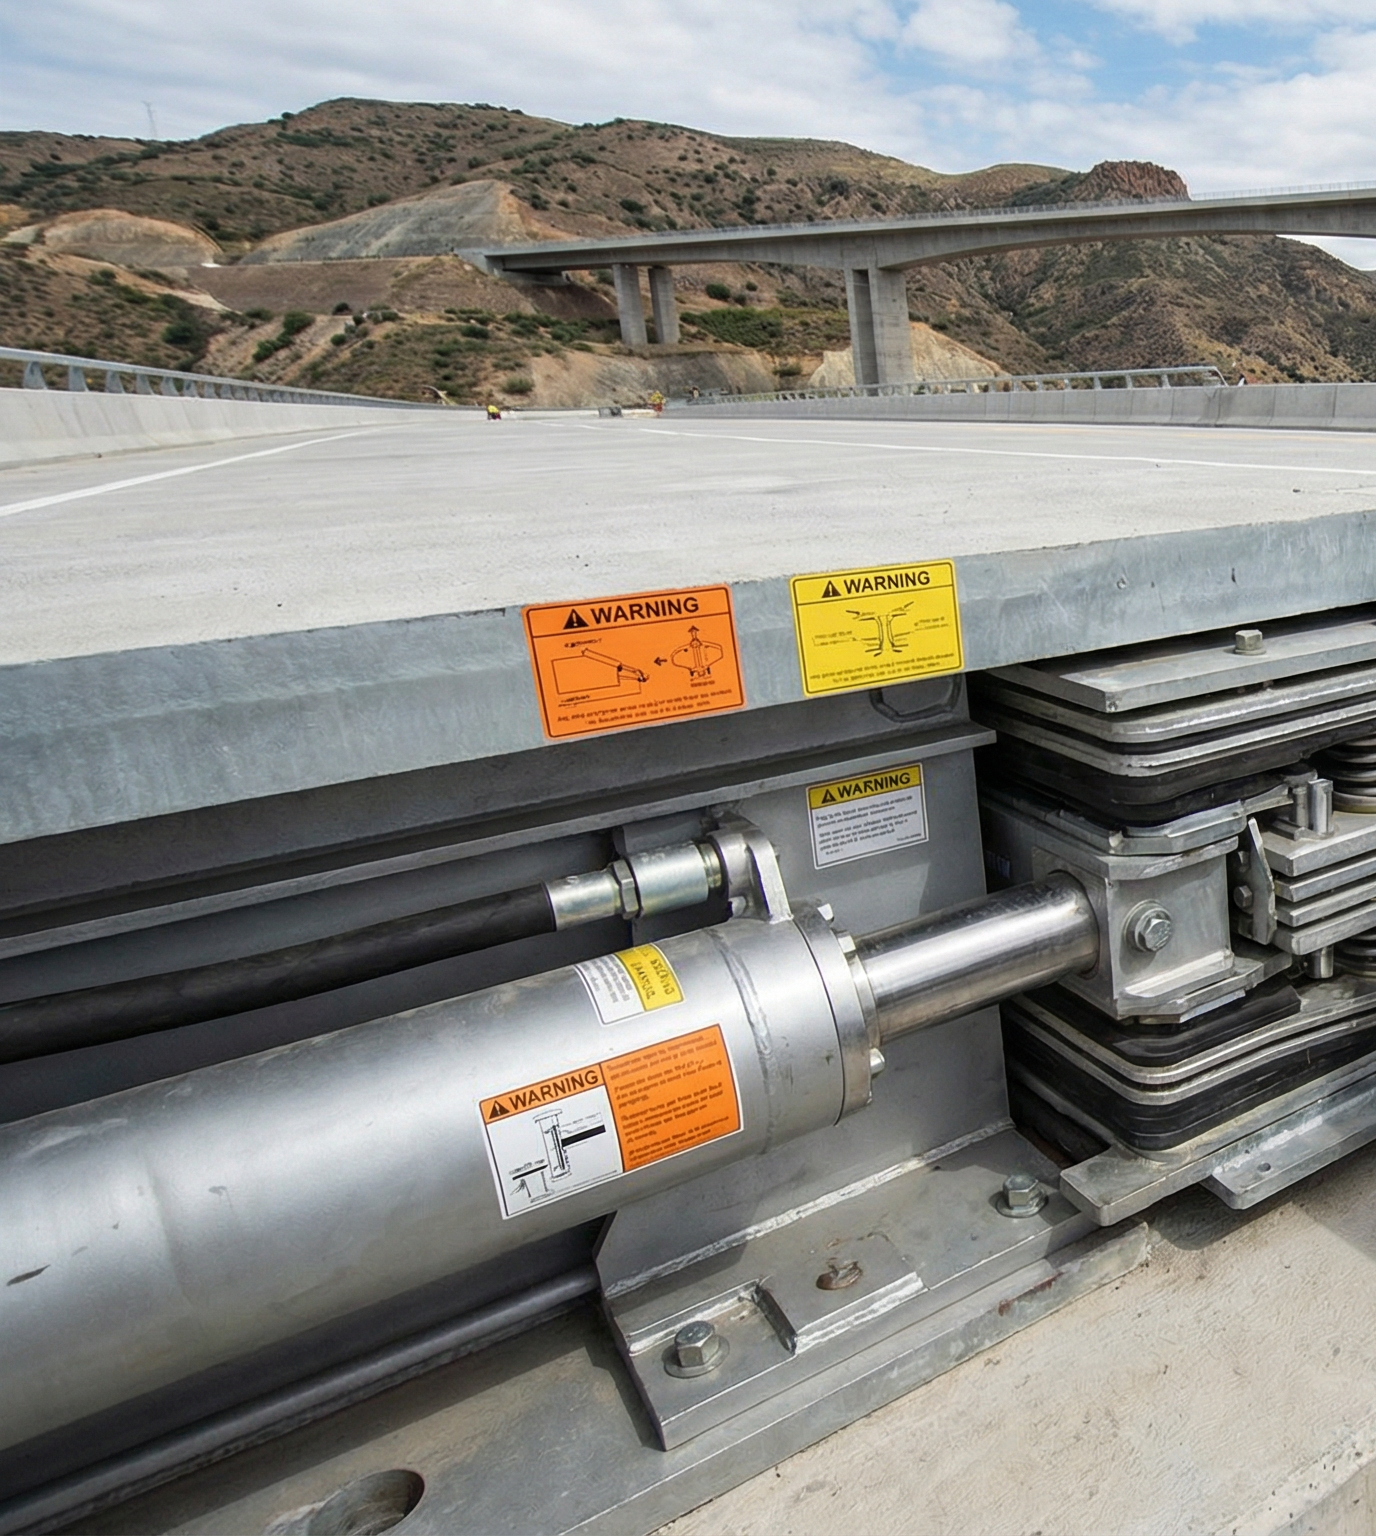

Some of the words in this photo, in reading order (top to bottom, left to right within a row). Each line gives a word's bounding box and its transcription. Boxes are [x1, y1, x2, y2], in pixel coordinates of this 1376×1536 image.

[844, 571, 930, 594] WARNING
[590, 596, 699, 625] WARNING
[837, 772, 911, 799] WARNING
[509, 1069, 599, 1111] WARNING
